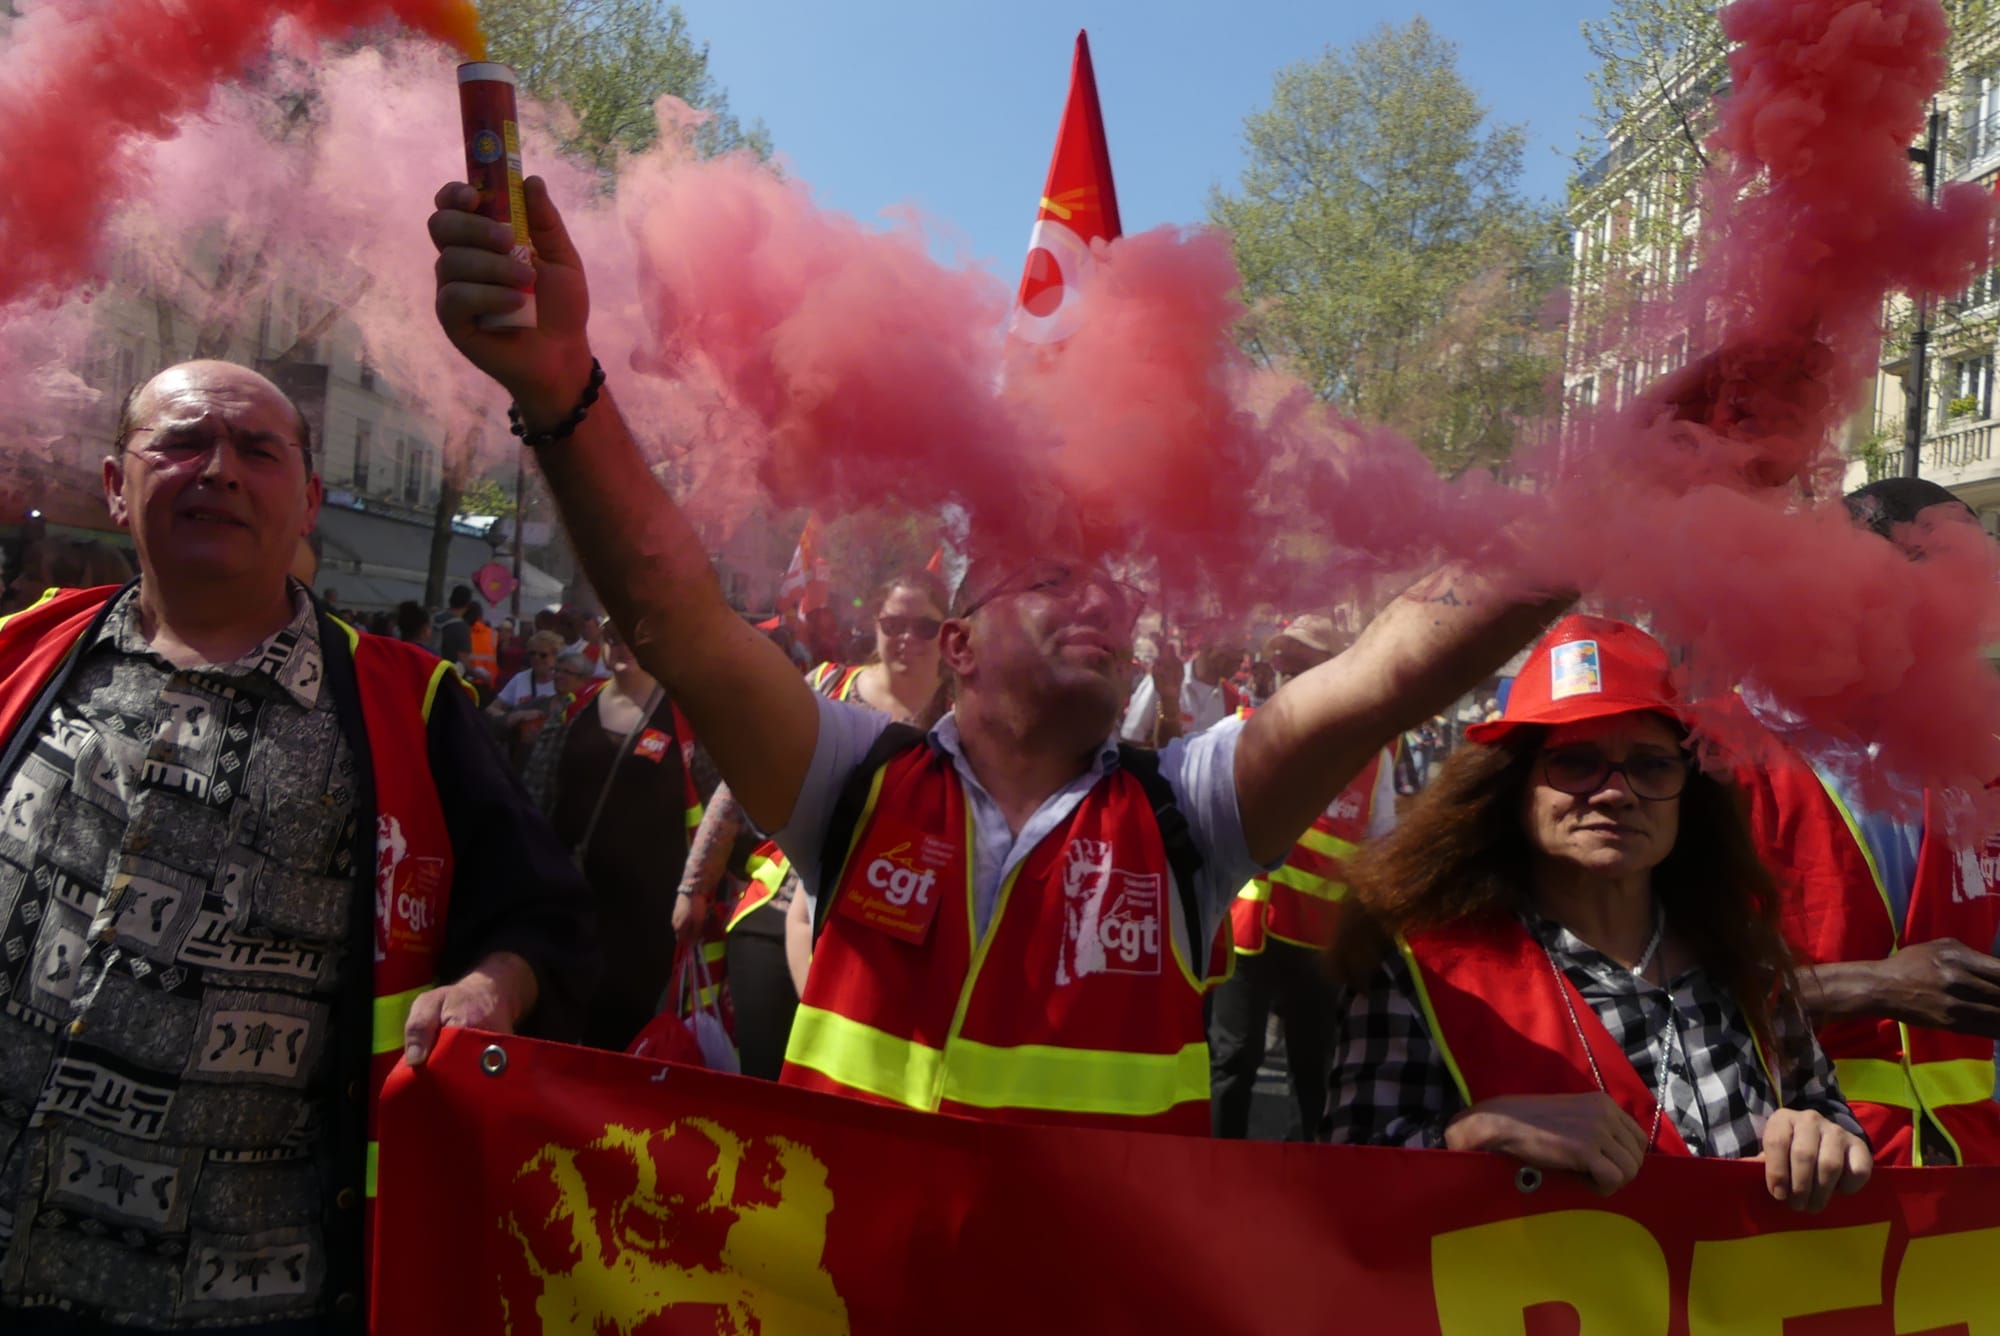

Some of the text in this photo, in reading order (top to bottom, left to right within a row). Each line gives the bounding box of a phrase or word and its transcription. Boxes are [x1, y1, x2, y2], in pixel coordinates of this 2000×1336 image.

[867, 858, 937, 905] cgt
[398, 894, 428, 932] cgt
[1099, 914, 1158, 962] cgt
